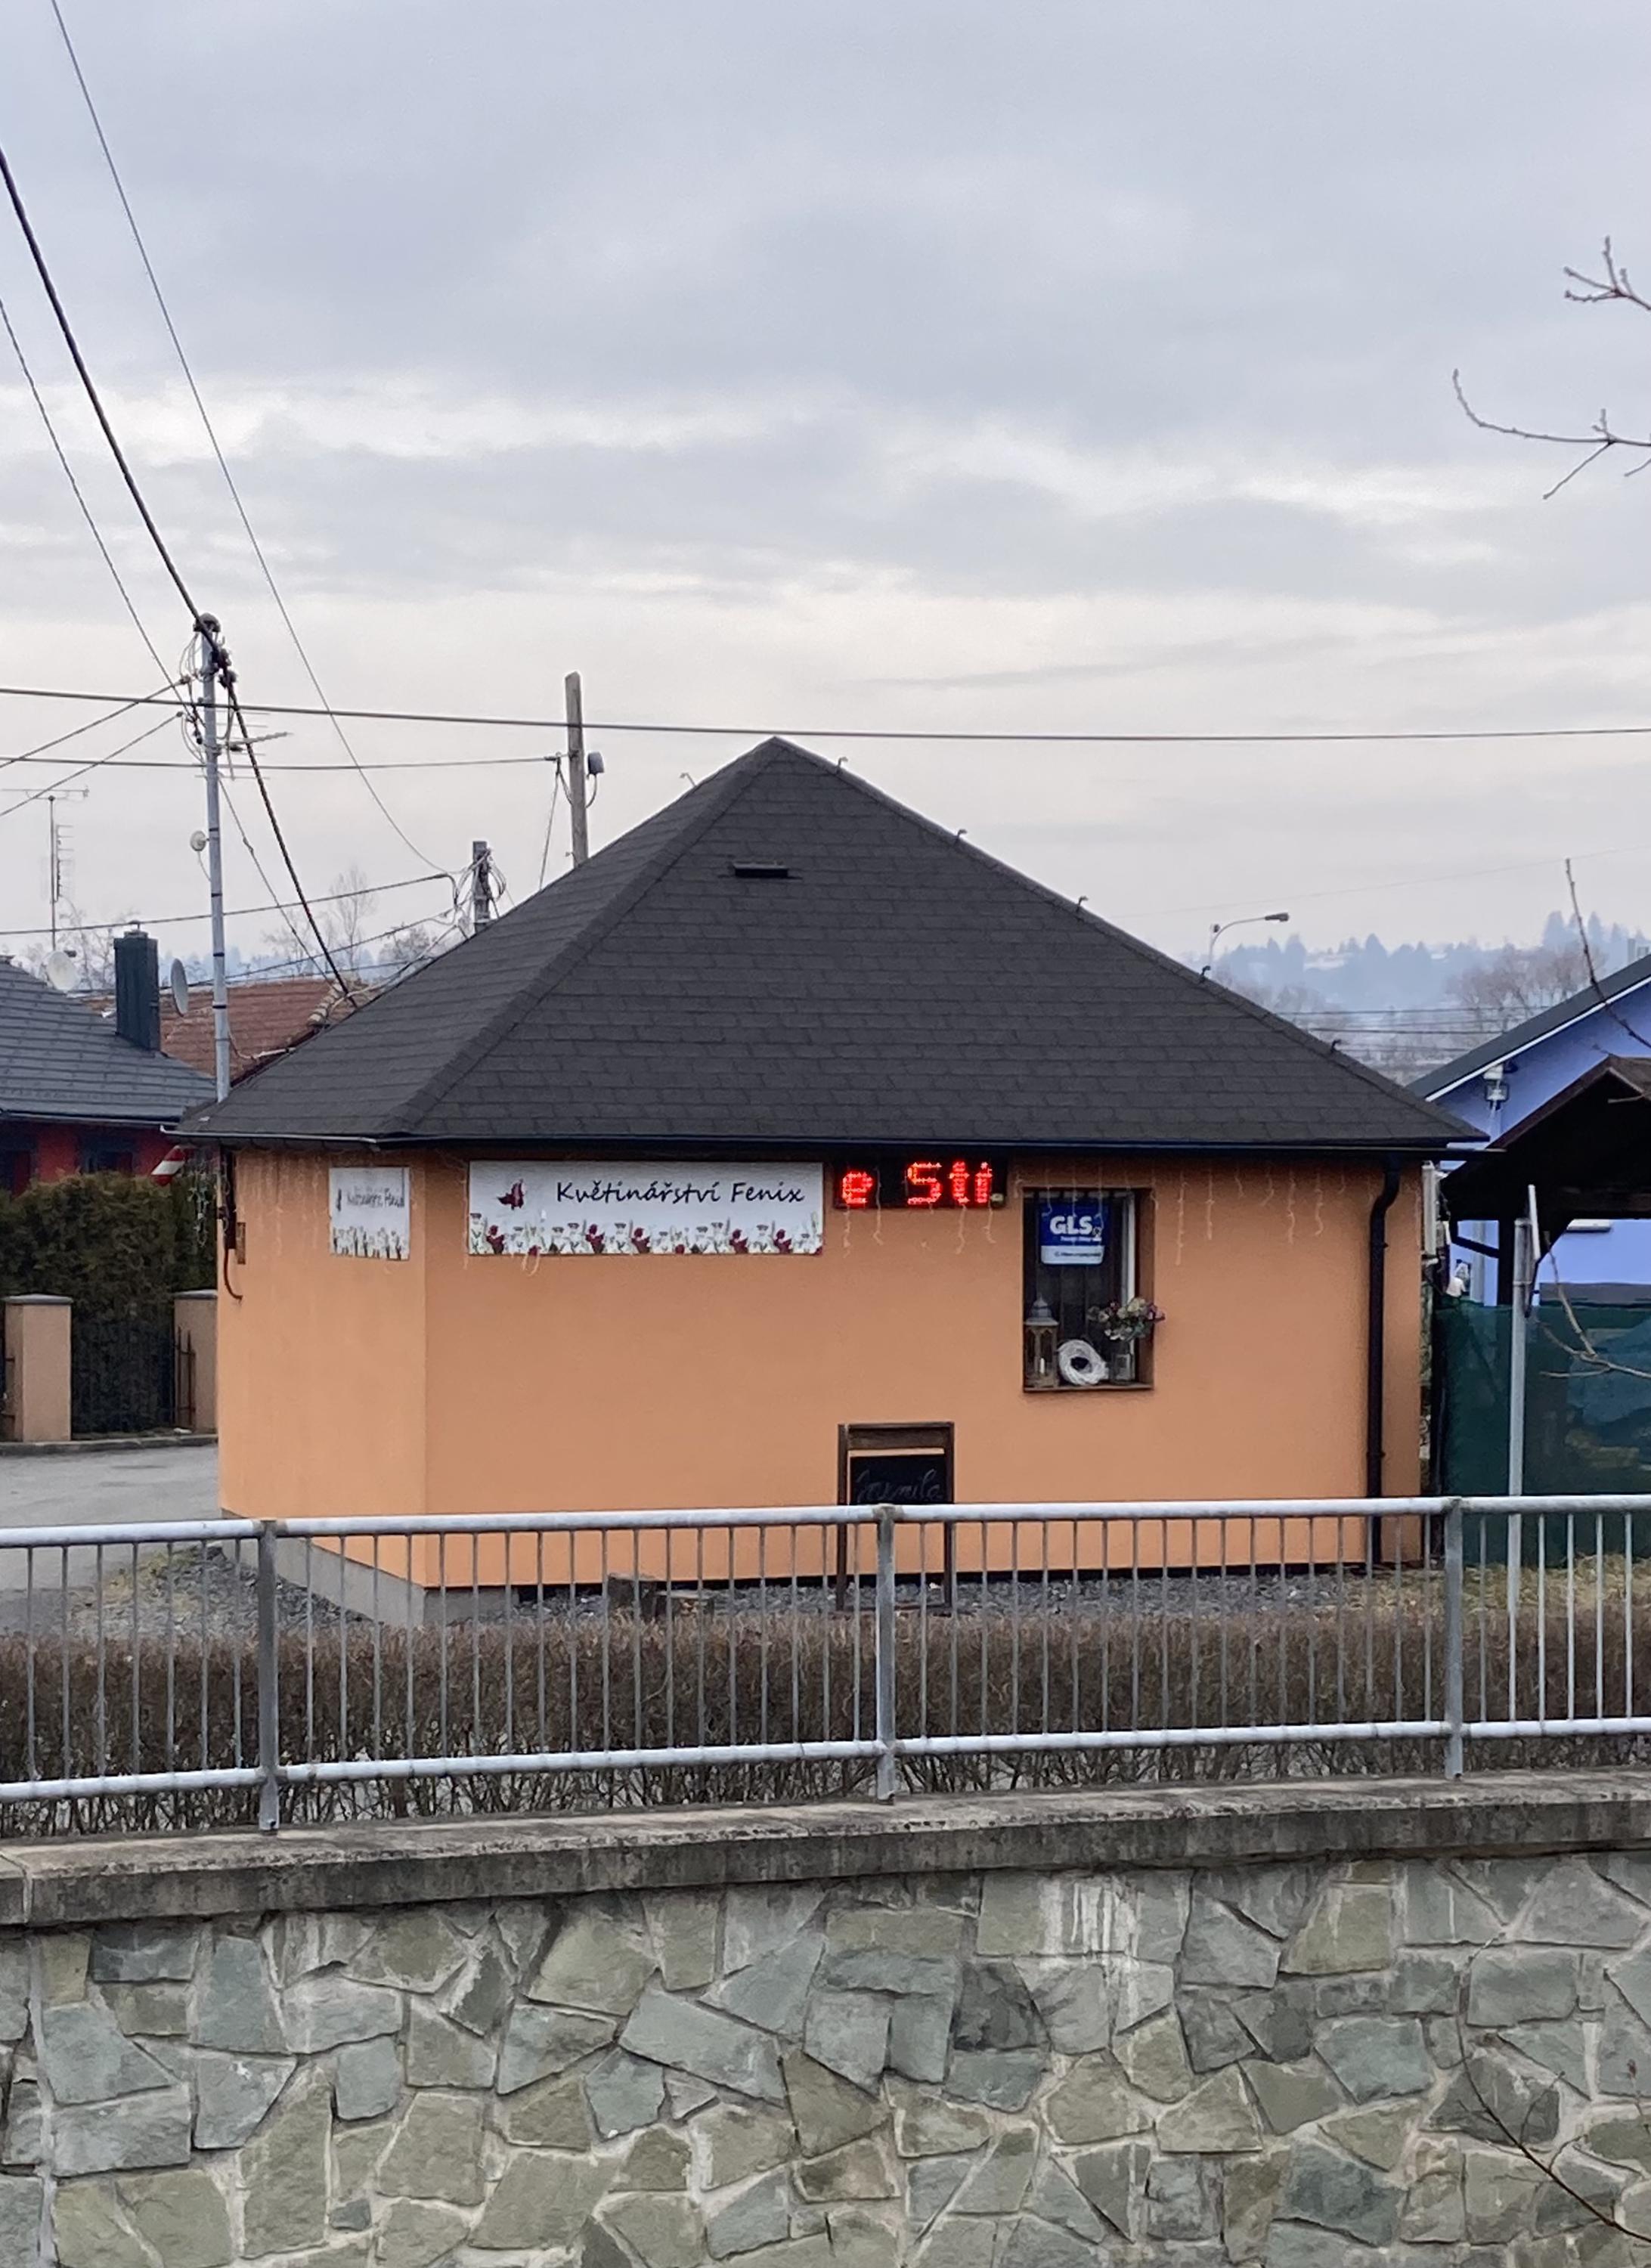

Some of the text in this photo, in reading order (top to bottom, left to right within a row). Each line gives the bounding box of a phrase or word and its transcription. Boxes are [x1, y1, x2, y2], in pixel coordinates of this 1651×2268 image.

[557, 1179, 805, 1204] Květinářství Fenix
[1049, 1215, 1093, 1235] GLS
